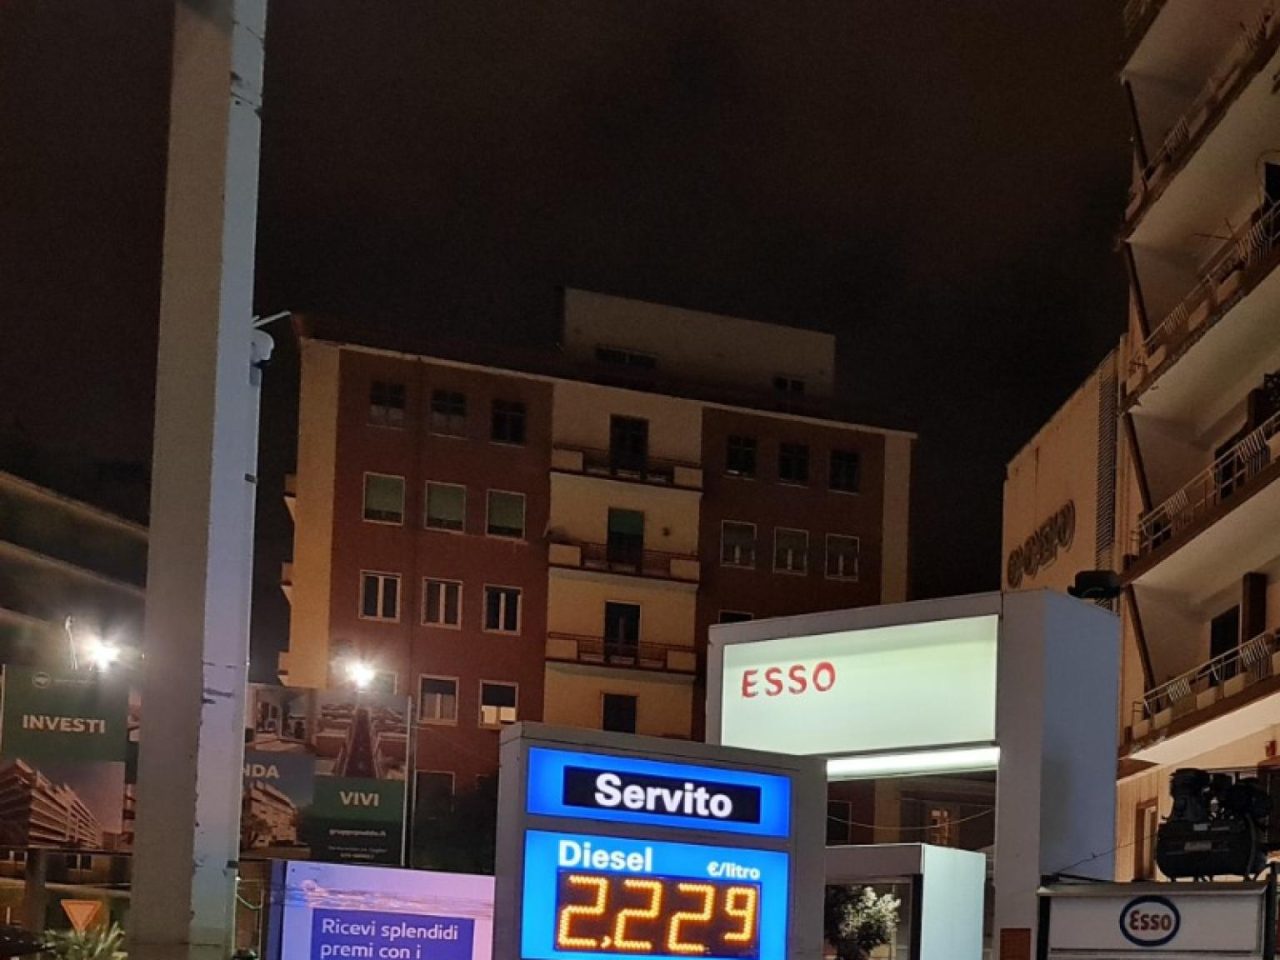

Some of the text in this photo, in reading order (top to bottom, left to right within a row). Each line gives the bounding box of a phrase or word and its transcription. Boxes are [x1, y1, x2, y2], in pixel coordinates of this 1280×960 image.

[741, 661, 837, 698] ESSO
[22, 714, 106, 734] INVESTI
[339, 790, 380, 807] VIVI
[594, 773, 733, 818] Servito
[557, 840, 761, 880] Diesel €/litro
[557, 875, 758, 953] 2,229
[1129, 910, 1171, 931] Esso
[321, 919, 459, 940] Ricevi splendidi
[320, 944, 421, 960] premi con i
